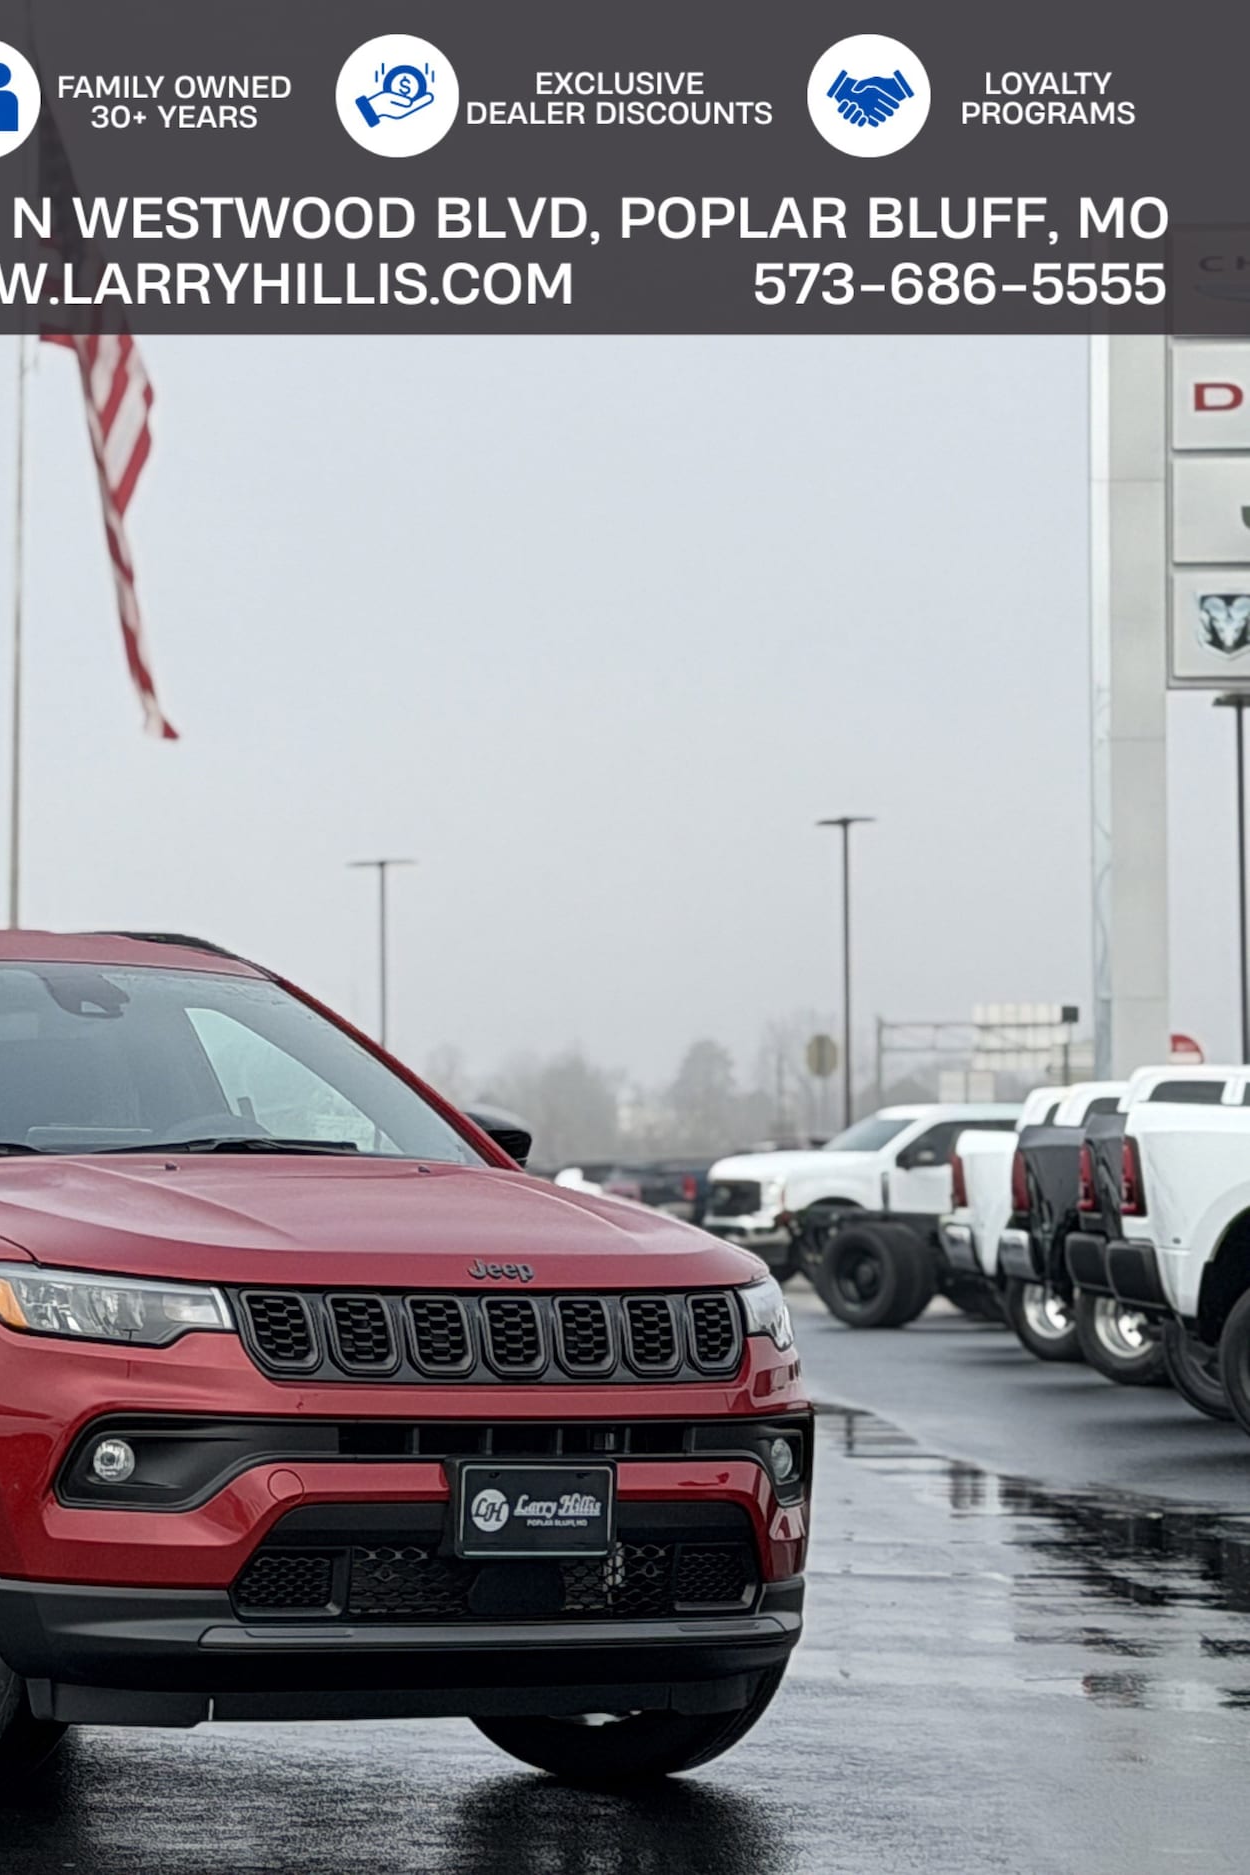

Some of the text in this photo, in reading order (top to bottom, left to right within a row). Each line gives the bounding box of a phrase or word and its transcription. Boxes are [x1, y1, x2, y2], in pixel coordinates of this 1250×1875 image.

[468, 1258, 534, 1283] Jeep
[513, 1493, 601, 1518] Larry Hillis
